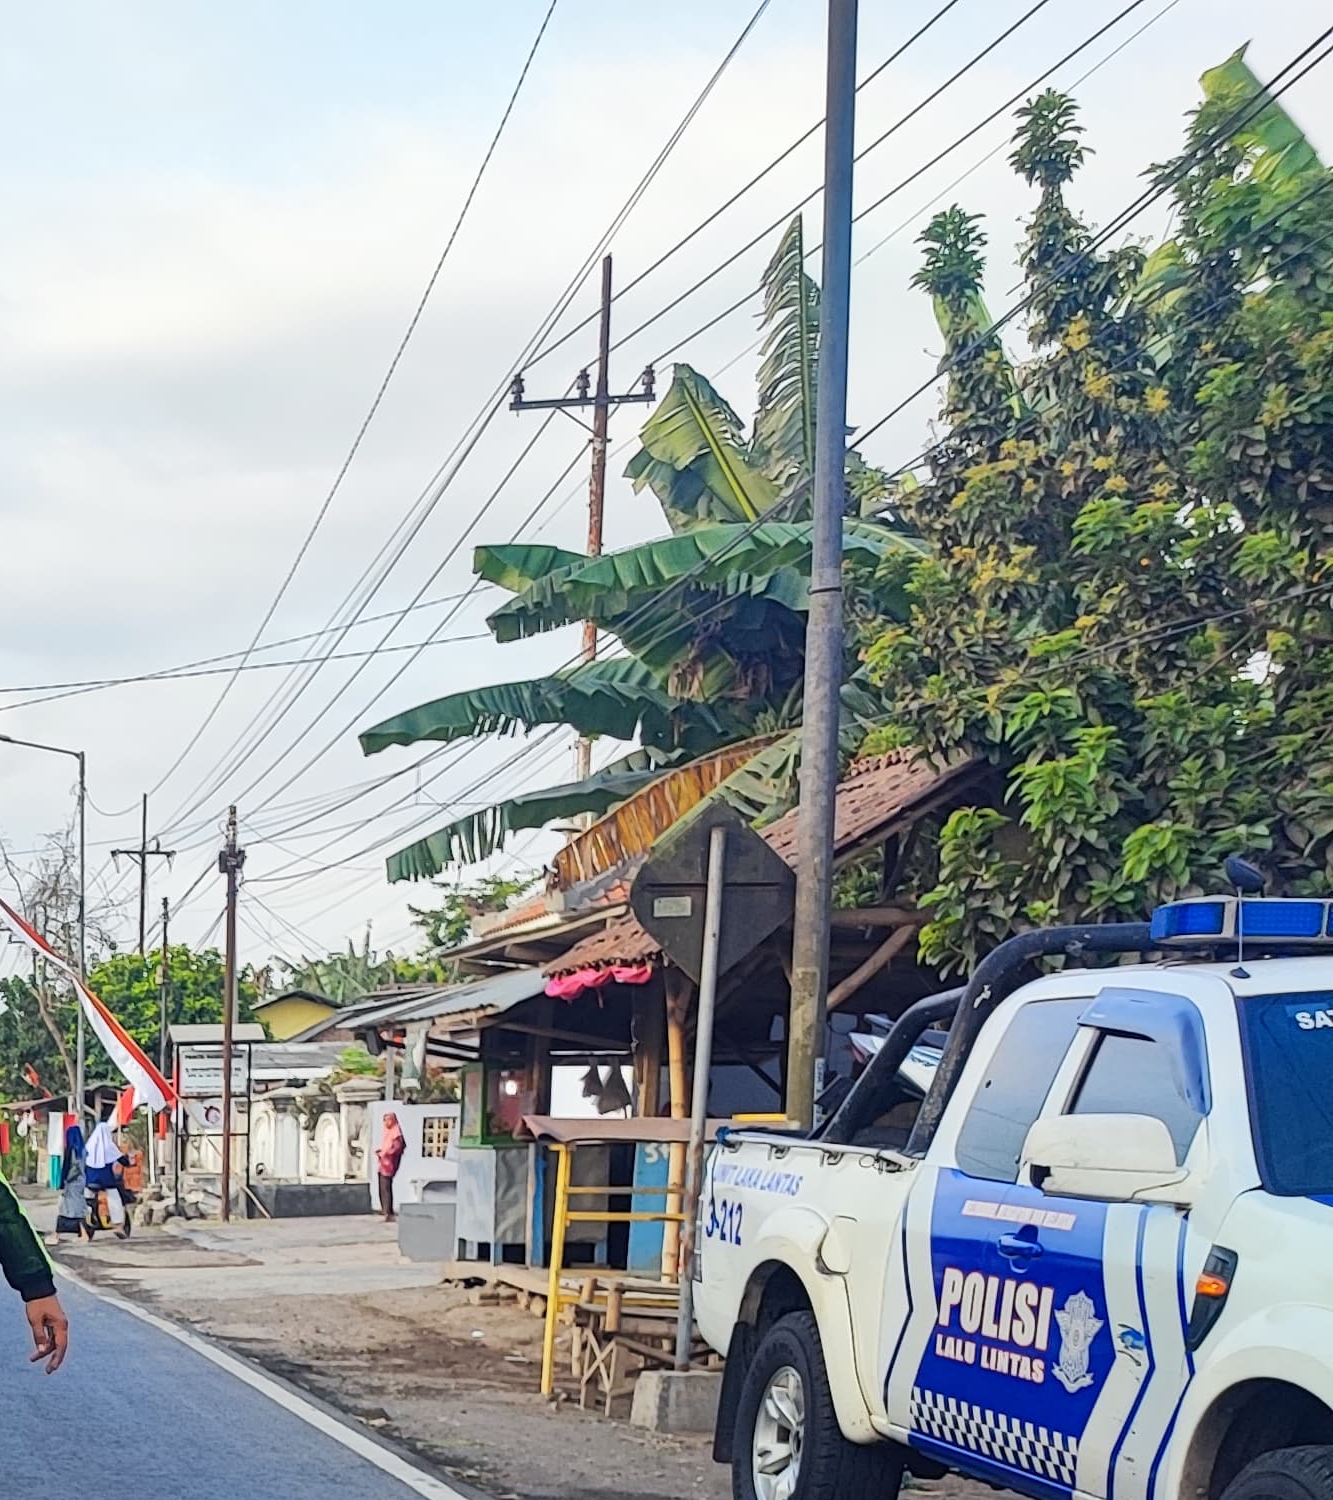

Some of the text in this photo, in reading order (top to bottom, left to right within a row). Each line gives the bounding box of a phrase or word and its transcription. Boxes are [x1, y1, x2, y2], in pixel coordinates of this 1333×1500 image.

[760, 1171, 803, 1197] LANTAS
[938, 1267, 1055, 1351] POLISI
[935, 1333, 1045, 1384] LALU LINTAS
